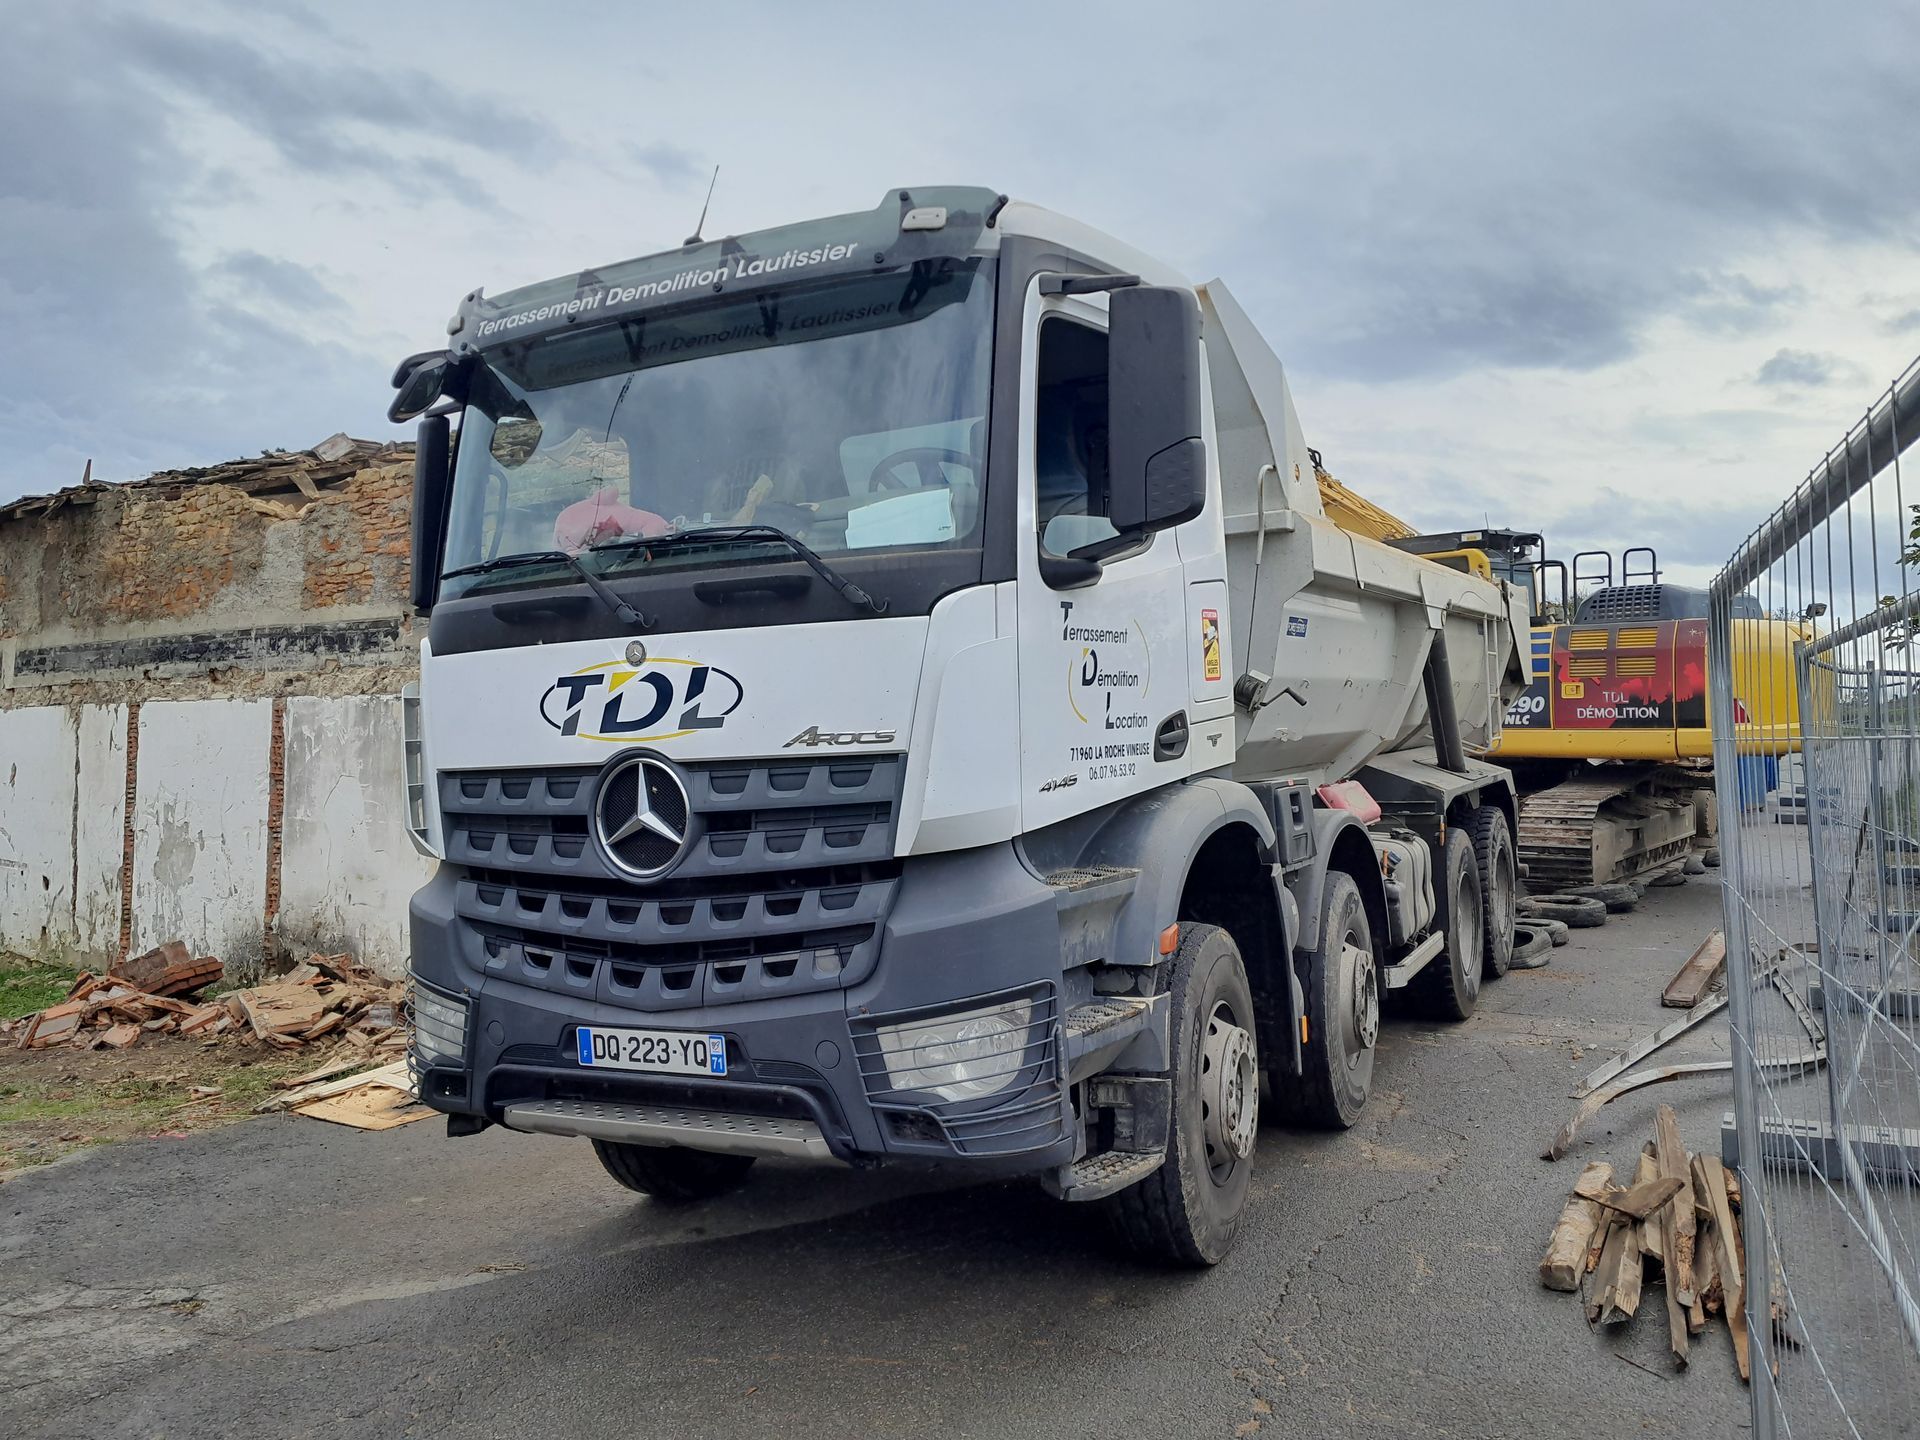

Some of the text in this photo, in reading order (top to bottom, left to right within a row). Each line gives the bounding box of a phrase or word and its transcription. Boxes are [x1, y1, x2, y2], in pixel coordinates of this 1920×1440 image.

[476, 240, 859, 338] Terrassement Demolition Lautissier
[1060, 601, 1128, 644] Terrassement
[1081, 647, 1139, 687] Démolition
[555, 666, 726, 737] TDL
[1105, 691, 1148, 730] Location
[1504, 714, 1531, 725] NLC
[1576, 705, 1660, 719] DÉMOLITION
[1070, 742, 1150, 762] 71960 LA ROCHE VINEUSE
[1039, 774, 1078, 793] 4145
[1089, 763, 1136, 781] 06.07.96.53.92
[593, 1034, 708, 1069] DQ-223-YQ
[711, 1056, 723, 1071] 71
